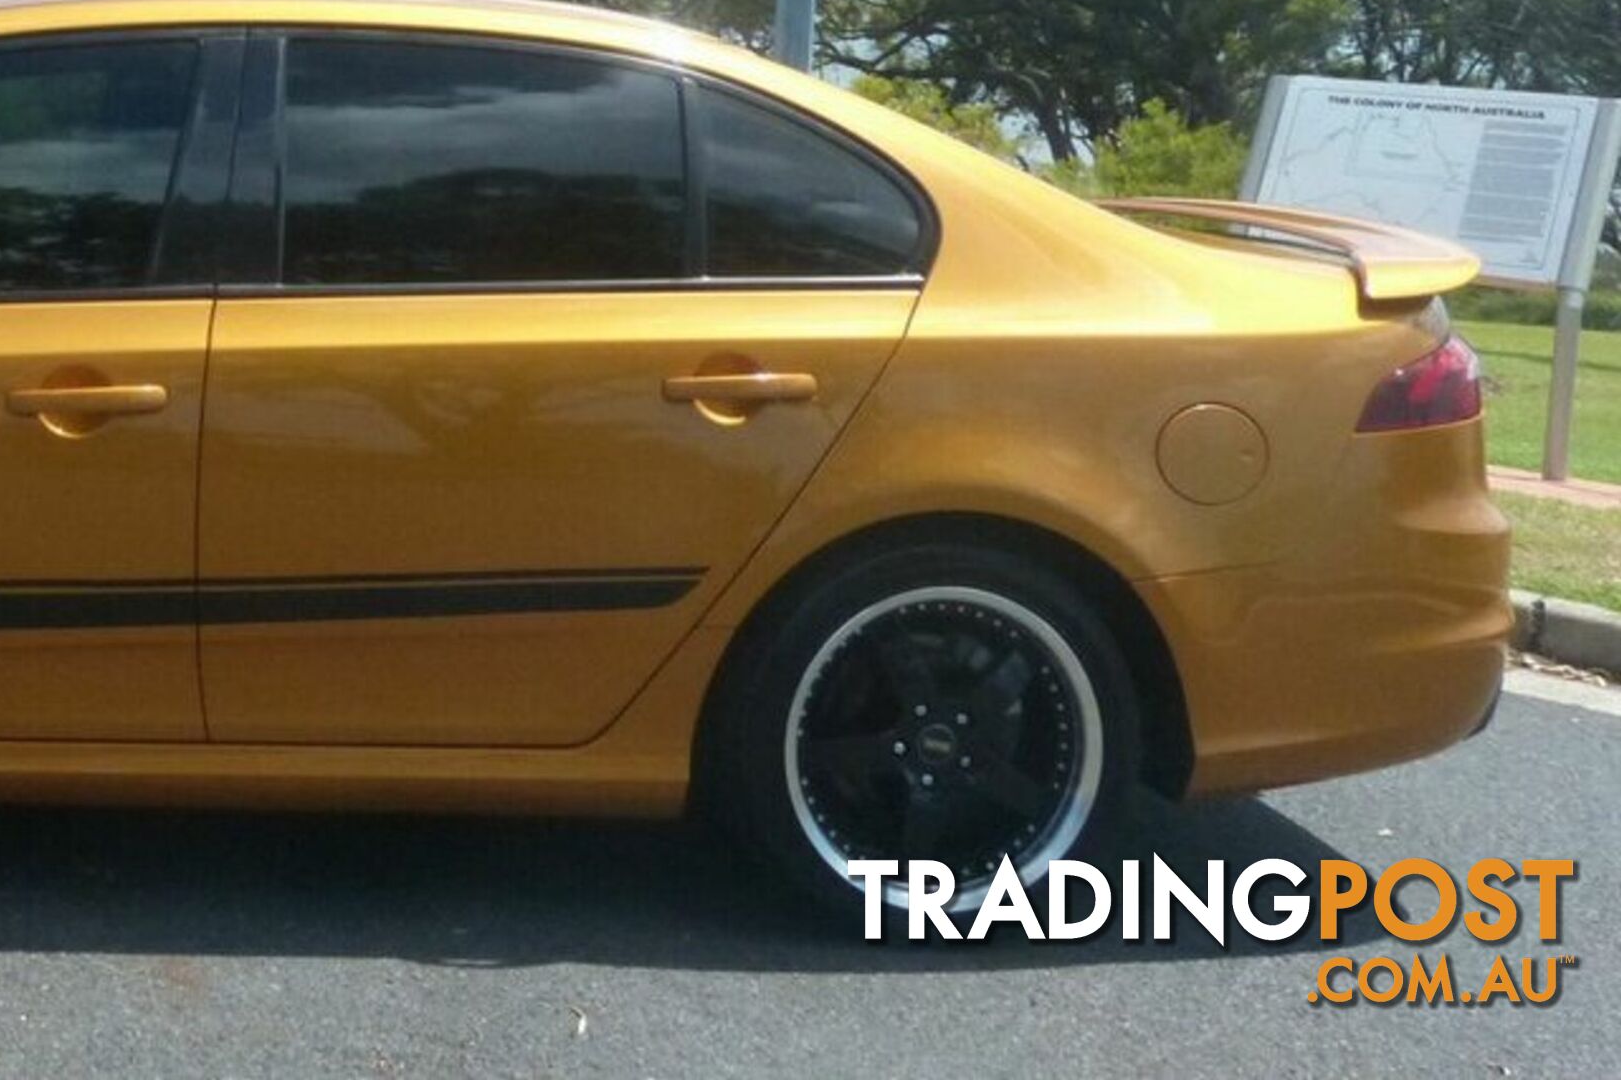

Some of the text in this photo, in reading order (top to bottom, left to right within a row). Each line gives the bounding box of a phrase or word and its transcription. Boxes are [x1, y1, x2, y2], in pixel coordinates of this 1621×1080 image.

[1405, 101, 1422, 111] OF
[1424, 103, 1469, 114] NORTH
[1472, 107, 1545, 119] AUSTRALIA
